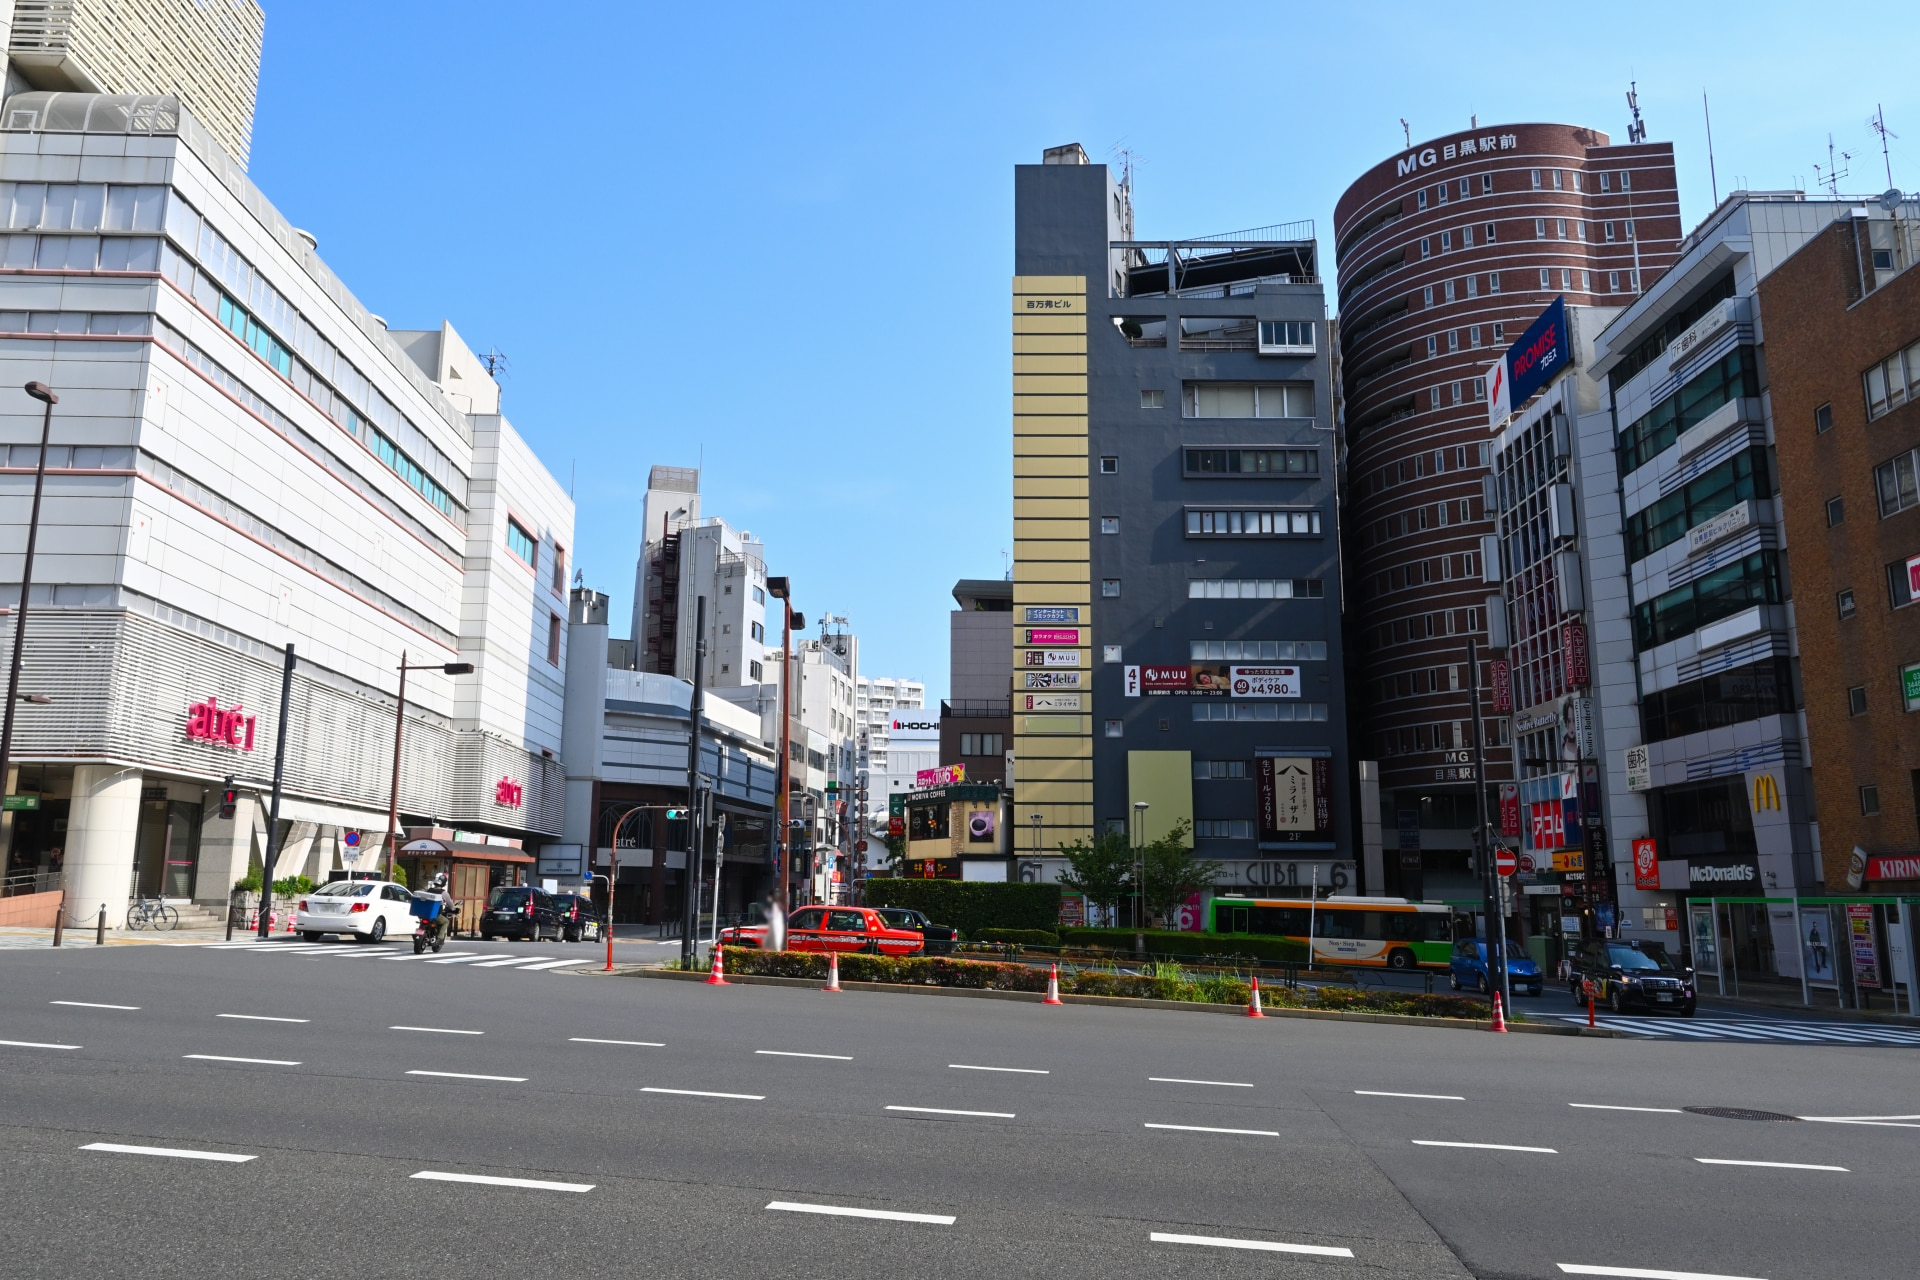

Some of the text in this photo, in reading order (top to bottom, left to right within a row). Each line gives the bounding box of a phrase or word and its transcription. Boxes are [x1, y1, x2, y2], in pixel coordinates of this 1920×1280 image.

[1397, 134, 1517, 177] MG 目黒駅前
[1026, 299, 1072, 309] 百万弗ビル
[1513, 323, 1557, 382] PROMISE
[1052, 673, 1077, 684] delta
[1128, 669, 1137, 693] 4F
[1160, 670, 1187, 679] MUU
[1237, 681, 1247, 689] 60
[902, 722, 940, 730] HOCHI
[1583, 700, 1594, 757] Neolive Butterfly
[1445, 751, 1469, 763] MG
[1627, 747, 1647, 769] 歯科
[929, 790, 946, 799] COFFEE
[1288, 775, 1299, 824] ミライザカ
[1508, 806, 1518, 828] アコム
[1533, 813, 1564, 836] アコム
[615, 836, 636, 848] atré
[1288, 832, 1301, 841] 2F
[1246, 862, 1298, 885] CUBA
[1689, 864, 1756, 882] McDonald's
[1879, 859, 1920, 879] KIRIN
